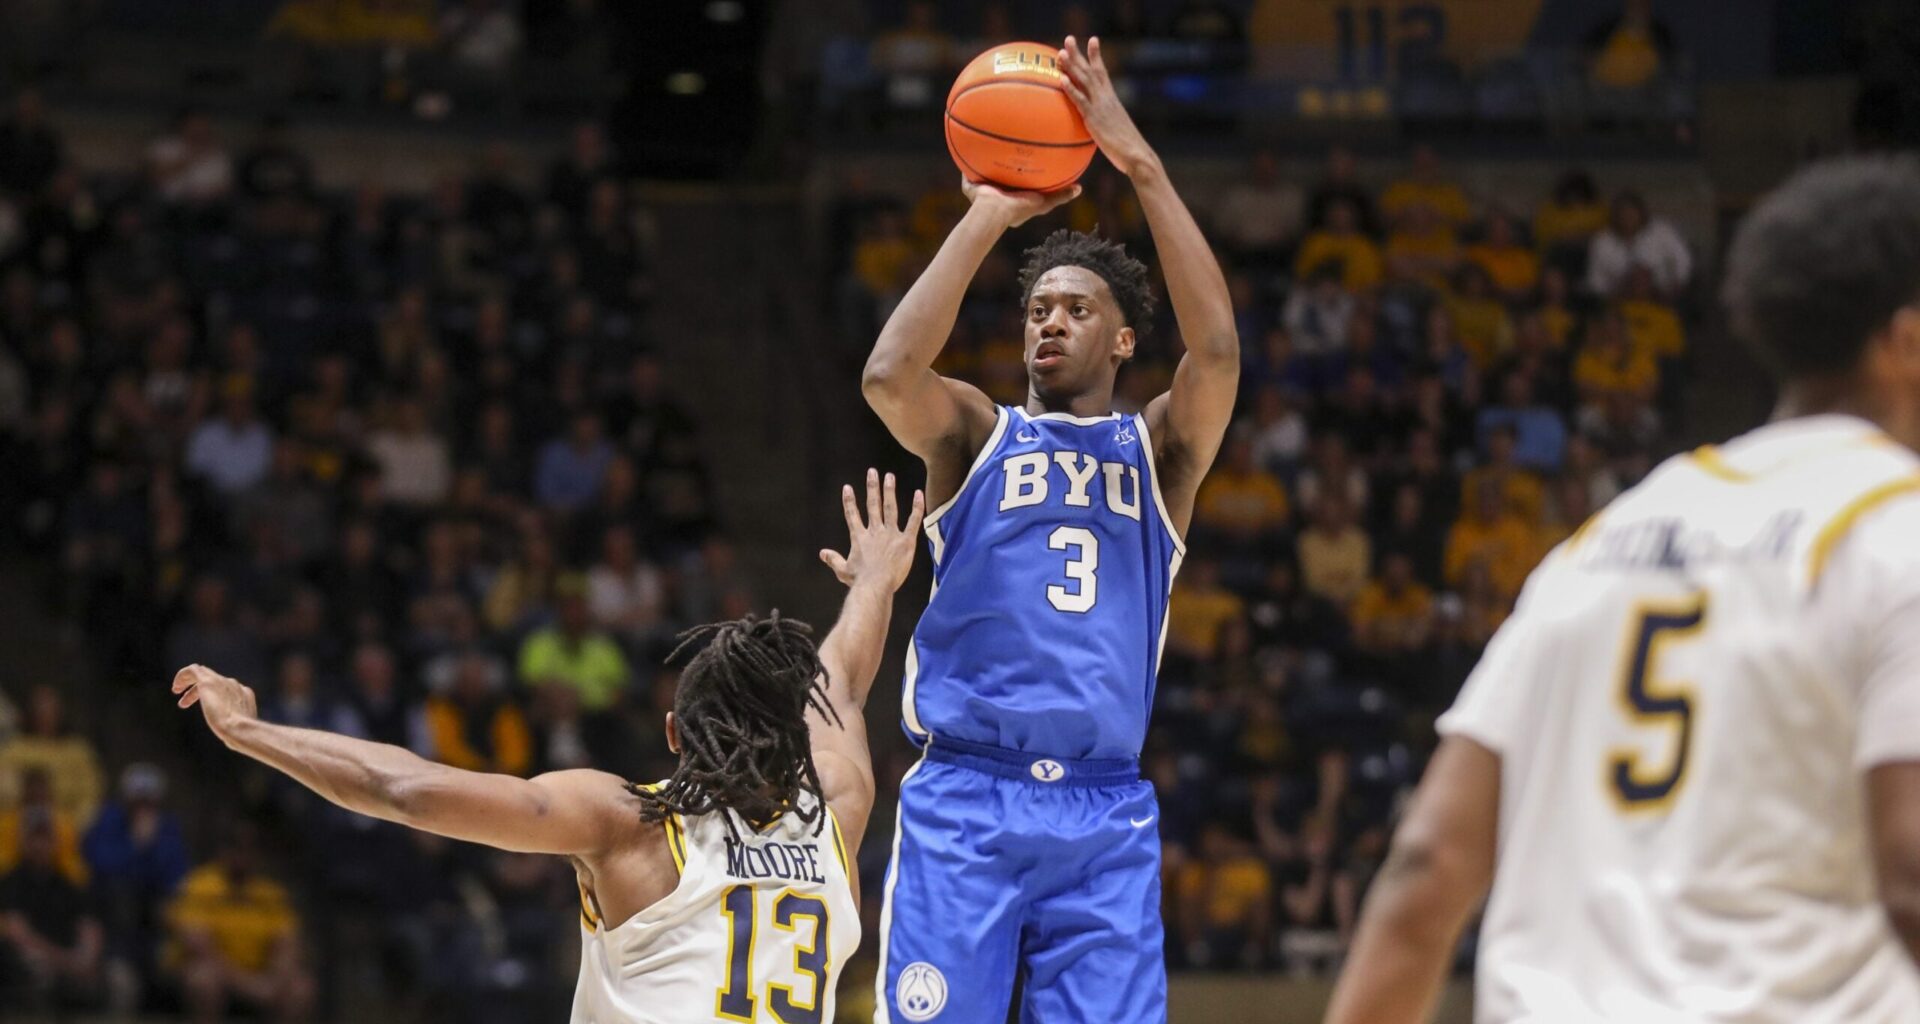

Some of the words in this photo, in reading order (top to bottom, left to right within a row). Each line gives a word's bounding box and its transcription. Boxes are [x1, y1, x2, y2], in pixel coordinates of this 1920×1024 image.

[995, 50, 1059, 69] ELIT
[998, 451, 1141, 522] BYU
[1046, 525, 1099, 614] 3
[1605, 590, 1706, 814] 5
[724, 836, 826, 884] MOORE
[715, 882, 832, 1024] 13
